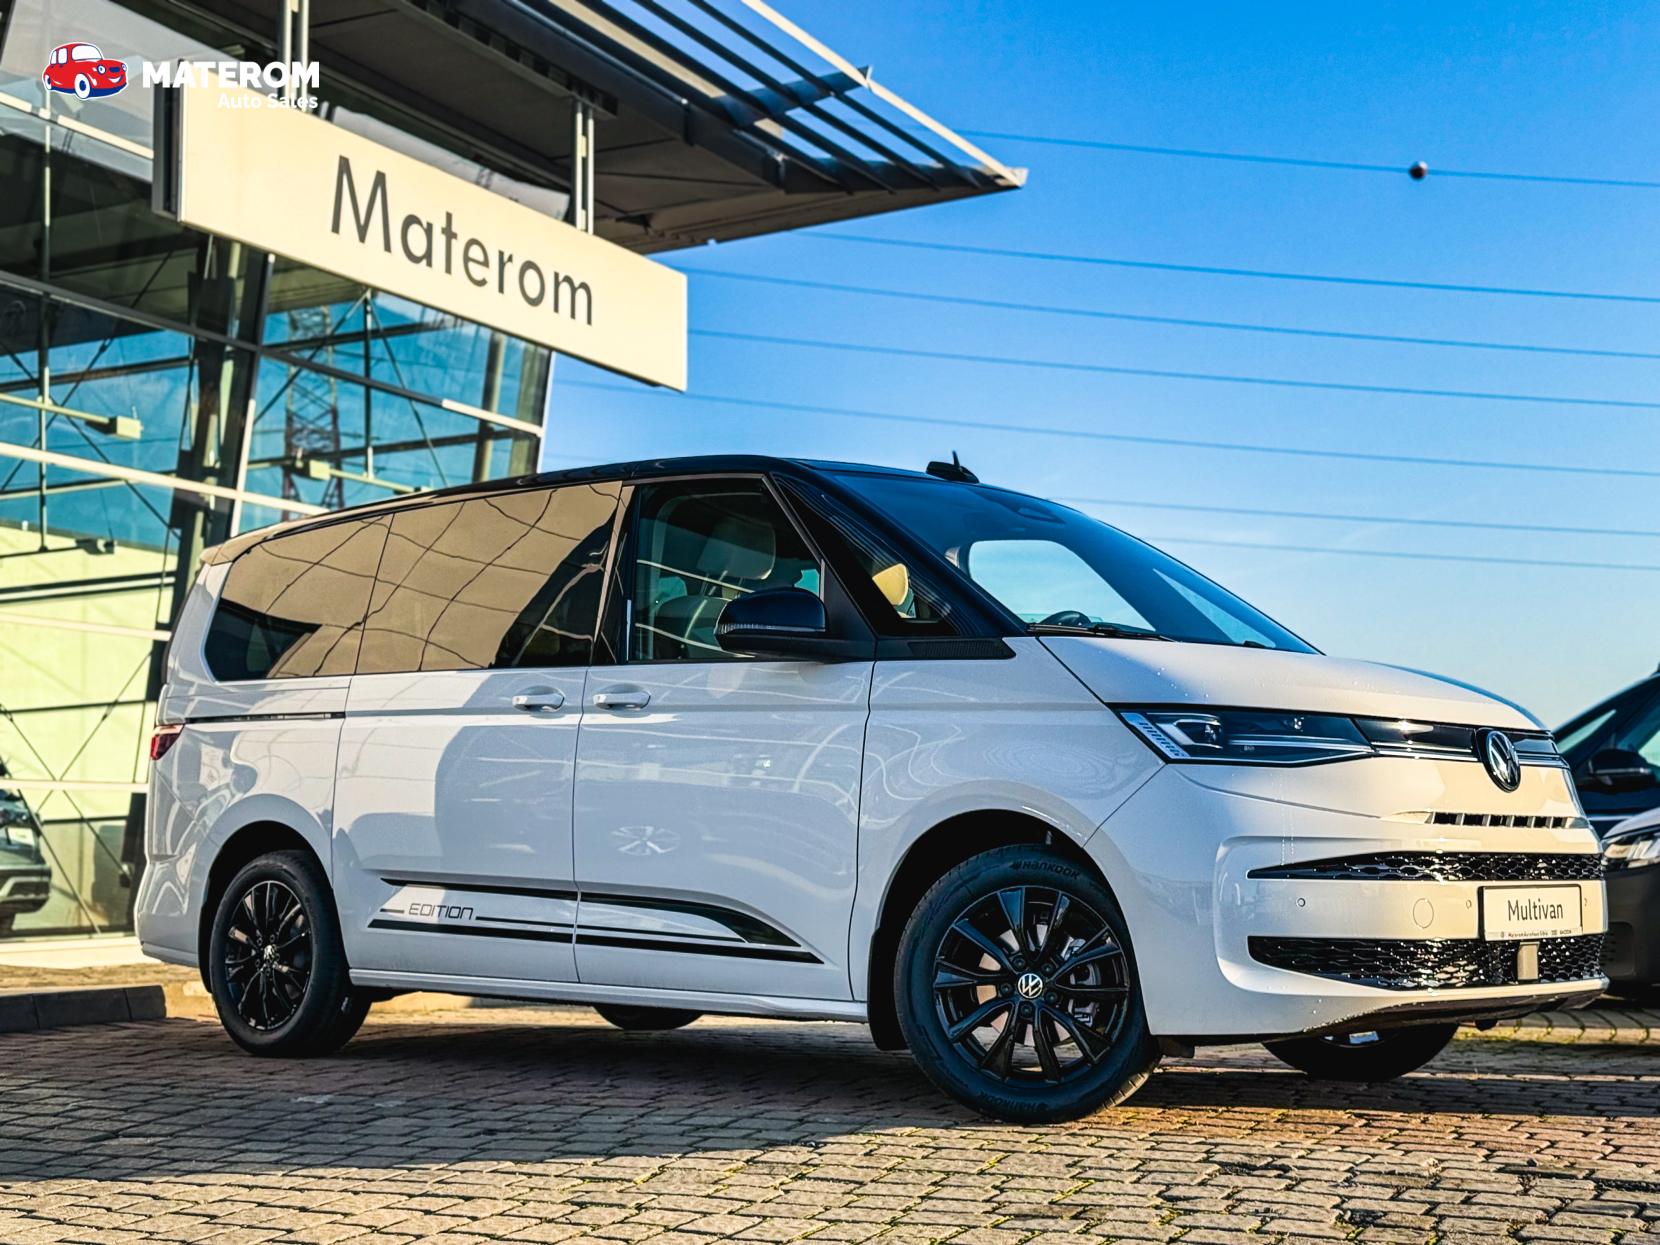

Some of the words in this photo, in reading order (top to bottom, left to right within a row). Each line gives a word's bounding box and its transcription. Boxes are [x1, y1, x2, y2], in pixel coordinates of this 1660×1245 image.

[331, 154, 592, 326] Materom
[408, 903, 474, 920] EDITION
[1507, 898, 1563, 921] Multivan
